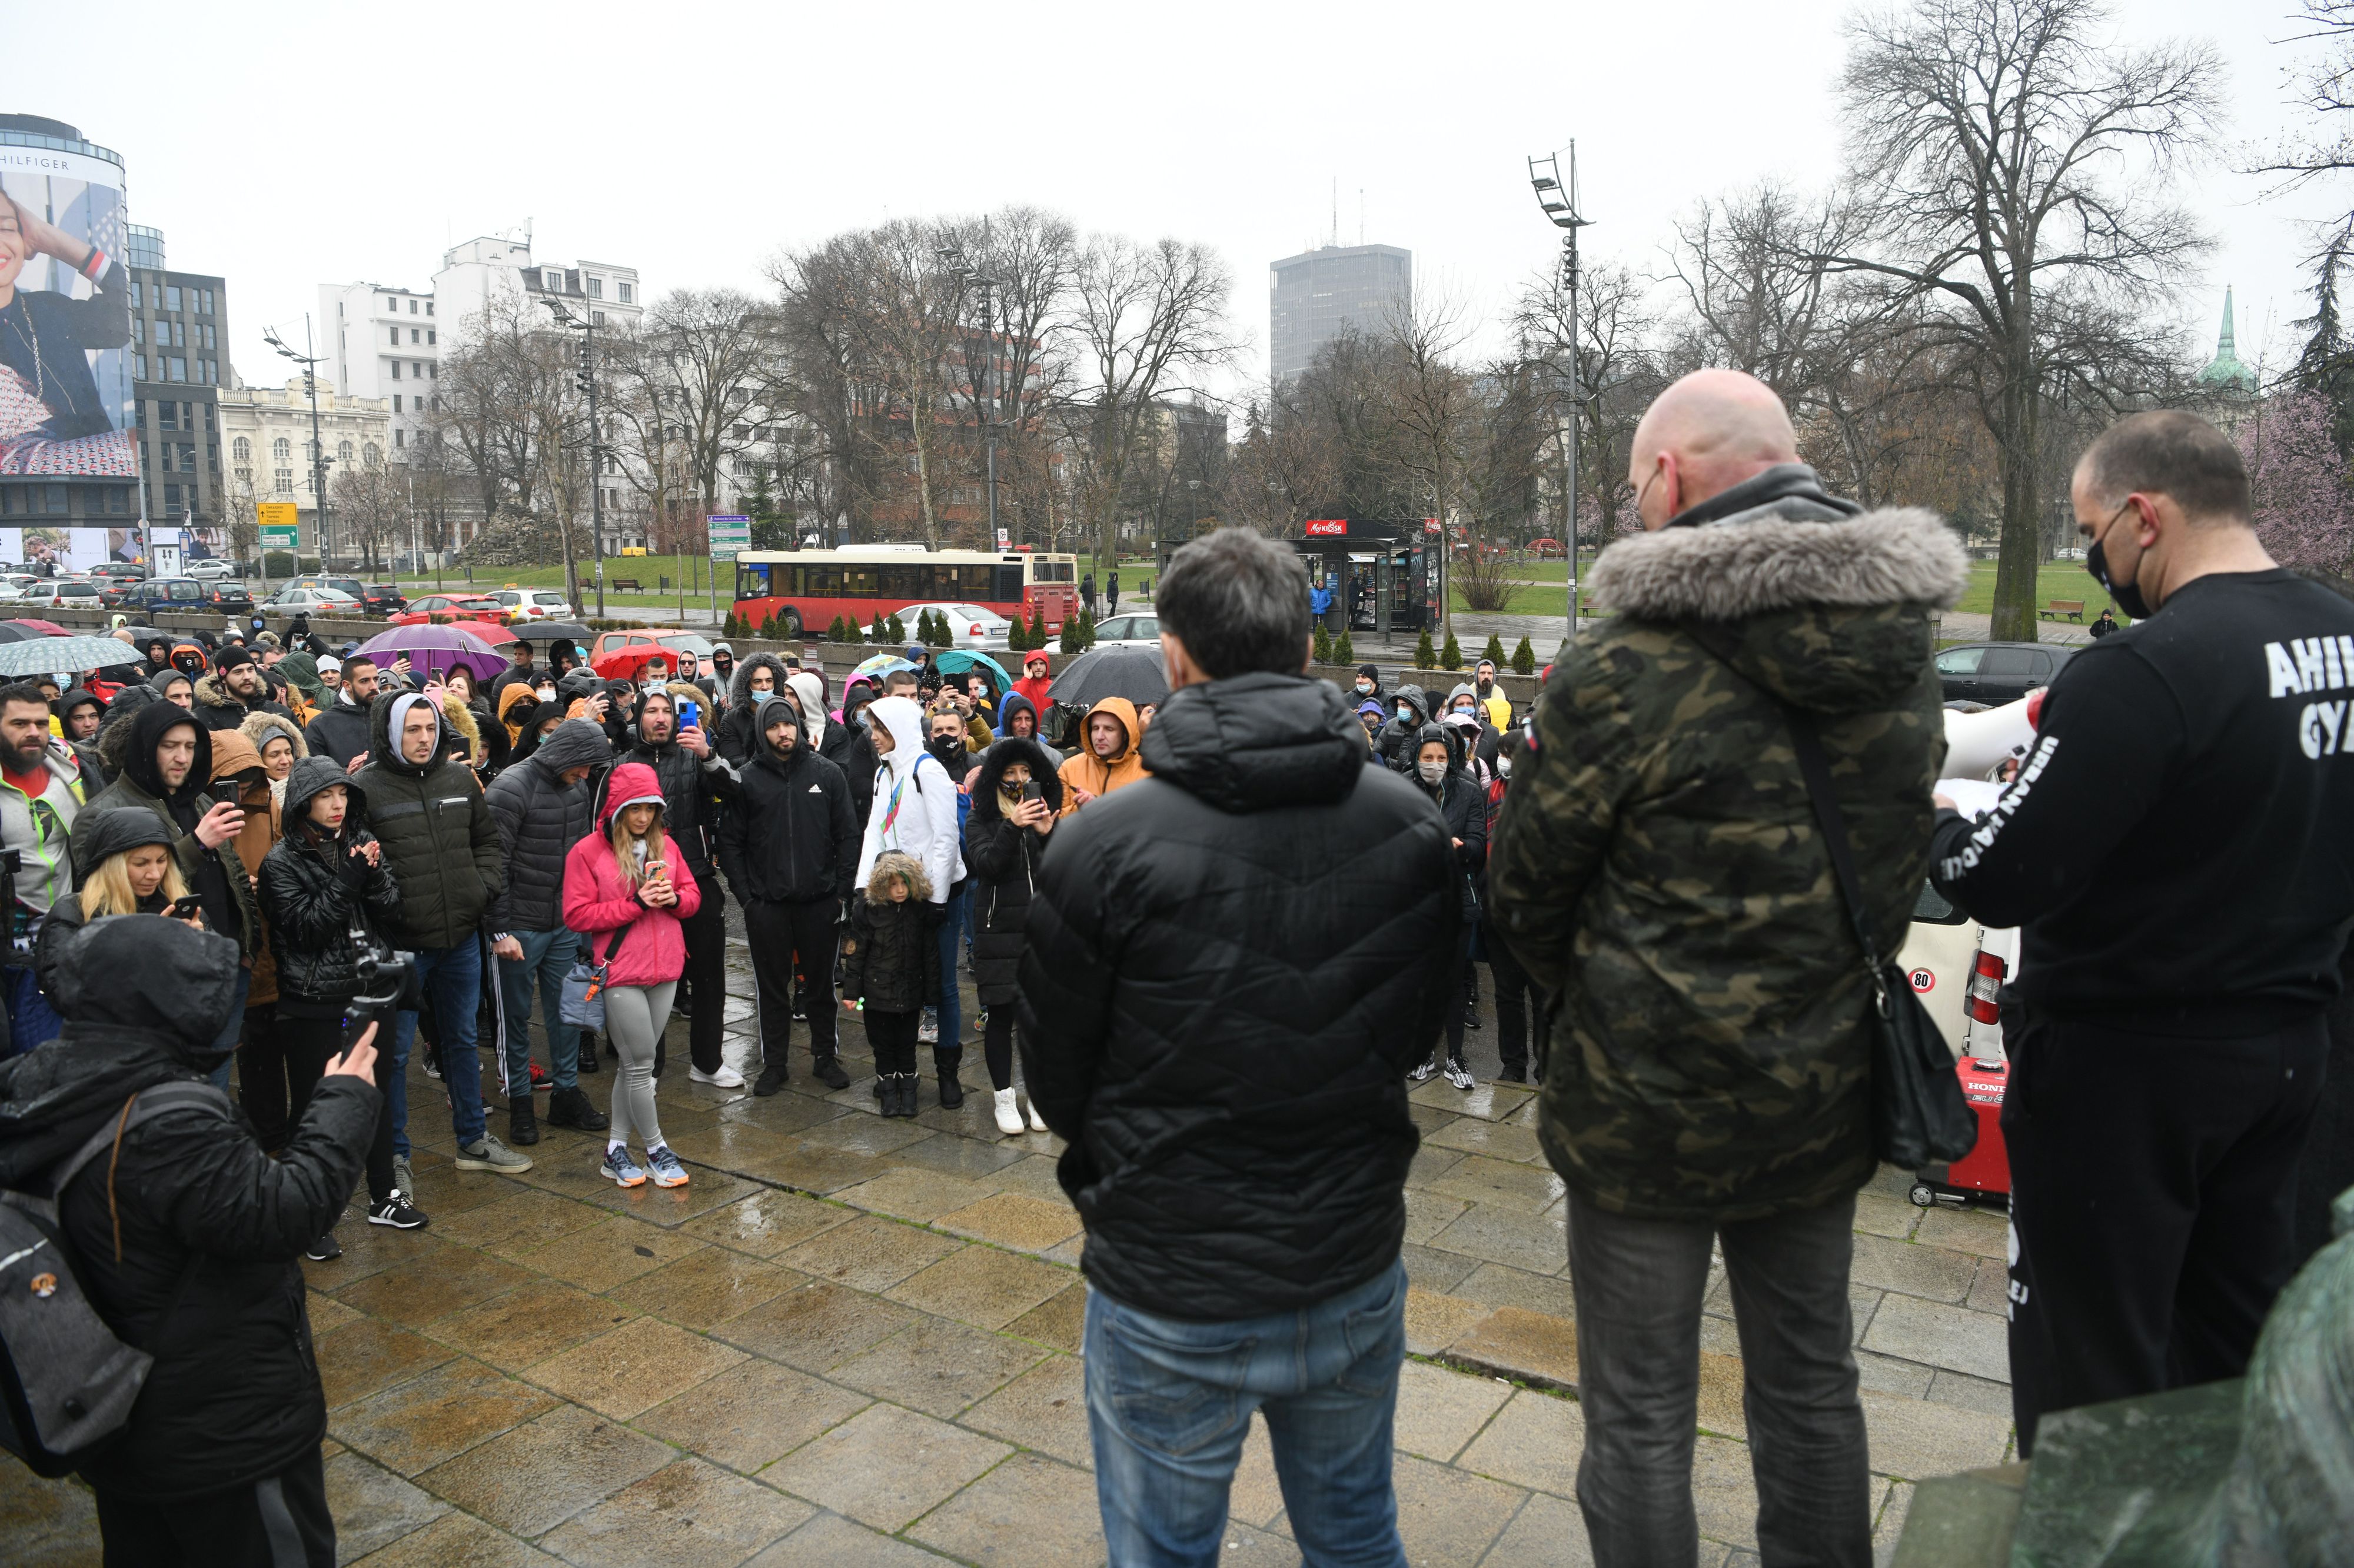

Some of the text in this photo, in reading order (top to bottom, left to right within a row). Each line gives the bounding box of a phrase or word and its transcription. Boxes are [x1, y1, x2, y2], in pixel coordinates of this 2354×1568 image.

[2299, 699, 2354, 760] GY
[1999, 735, 2059, 817] URBAN
[1914, 973, 1929, 987] 80
